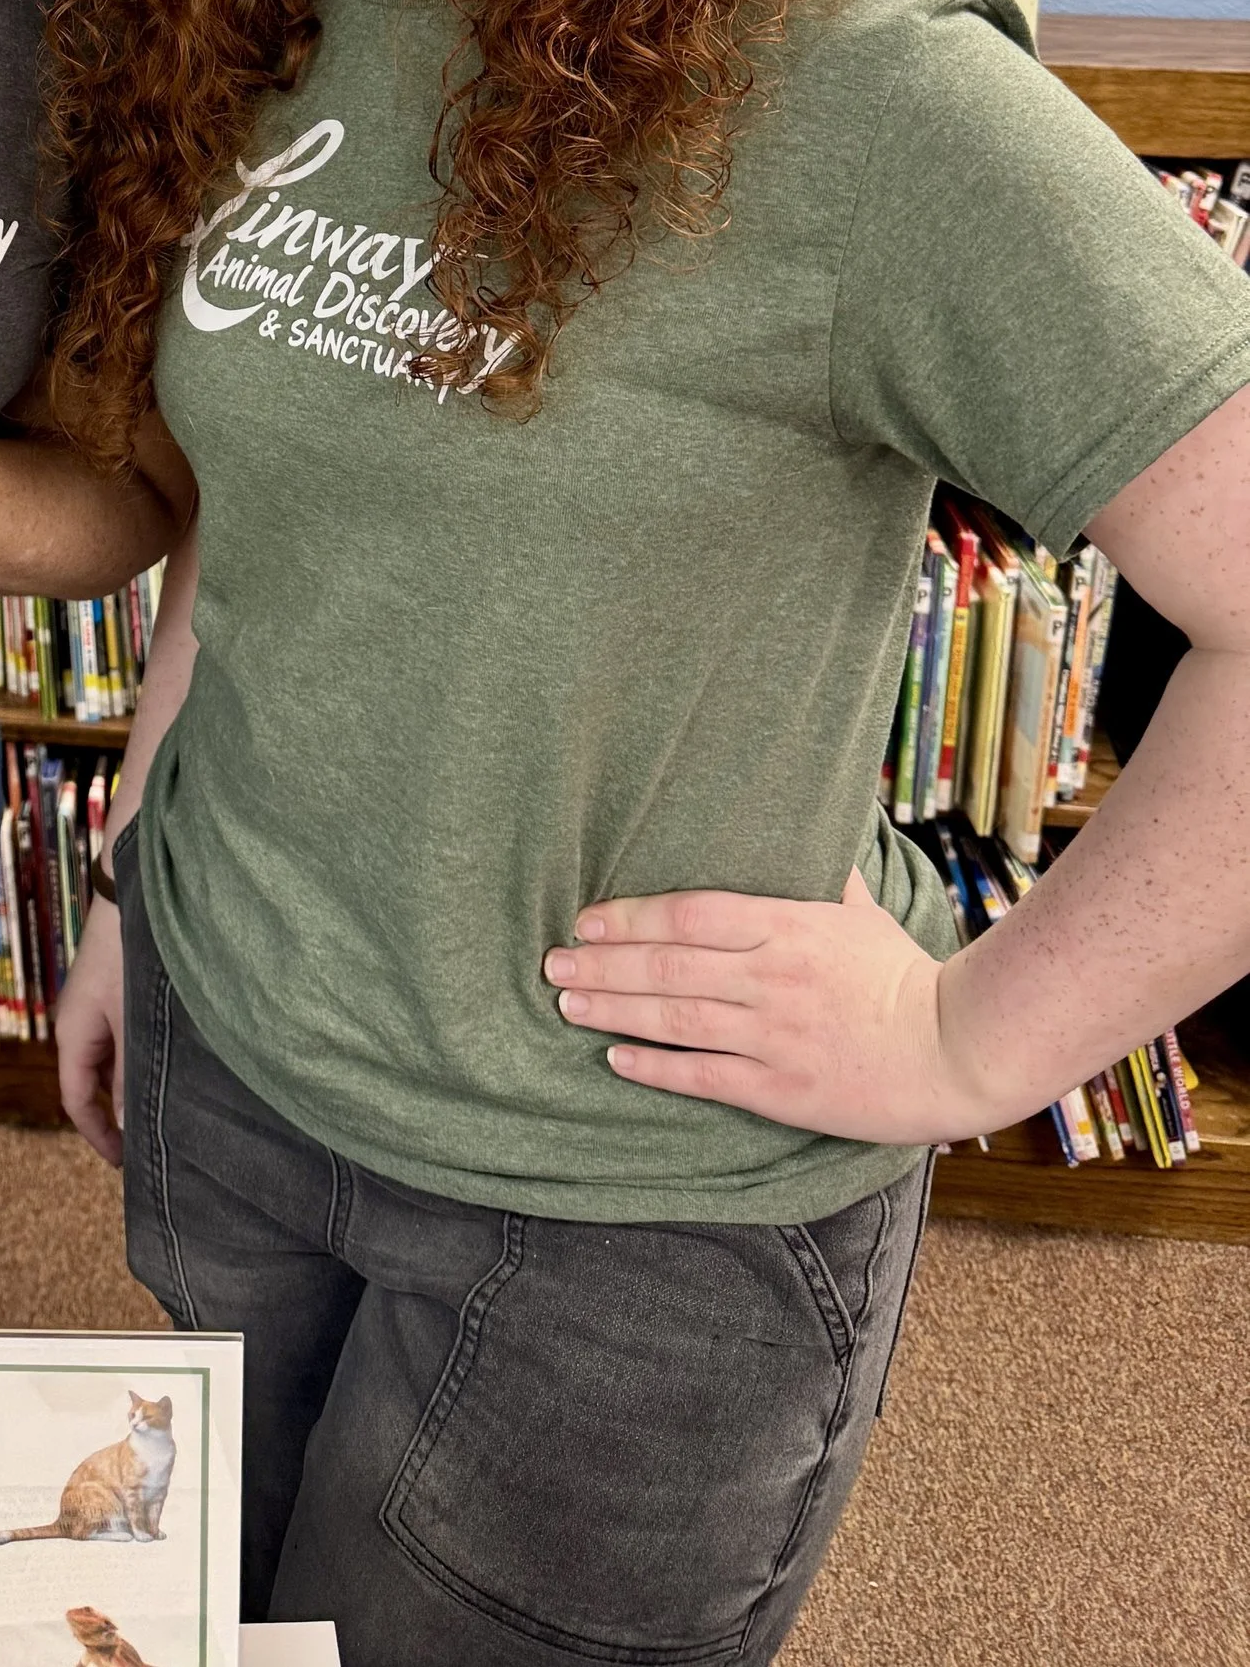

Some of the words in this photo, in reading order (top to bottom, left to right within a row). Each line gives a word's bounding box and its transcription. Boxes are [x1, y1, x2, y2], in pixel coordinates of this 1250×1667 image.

[180, 119, 489, 332] Linway
[200, 244, 314, 307] Animal
[258, 308, 282, 340] &
